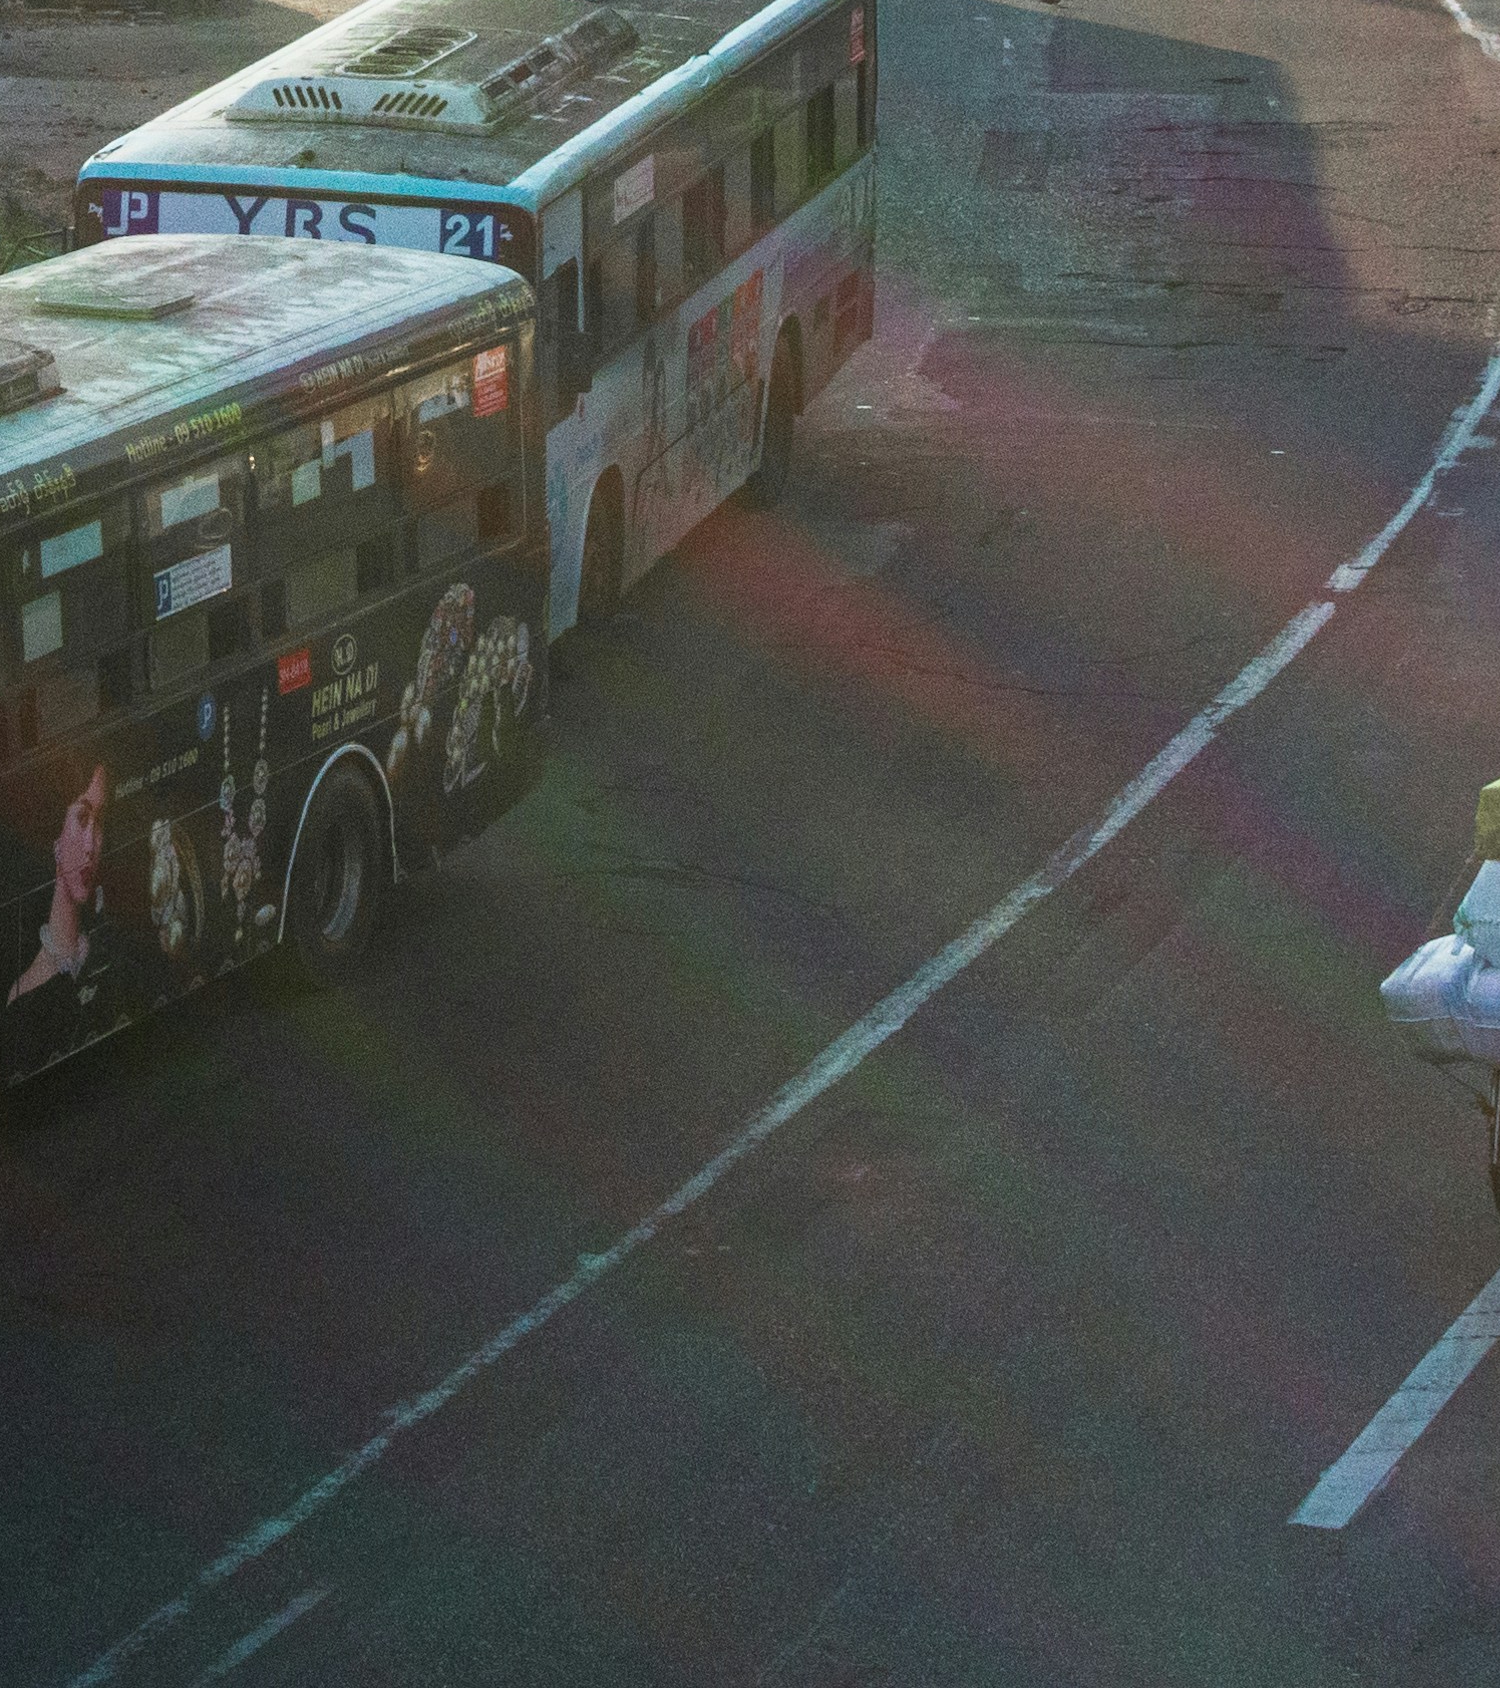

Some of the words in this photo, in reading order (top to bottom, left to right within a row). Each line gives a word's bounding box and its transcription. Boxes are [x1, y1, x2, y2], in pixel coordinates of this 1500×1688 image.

[443, 211, 494, 258] 21
[312, 678, 343, 718] HEIN
[345, 670, 363, 703] NA
[365, 660, 380, 694] DI
